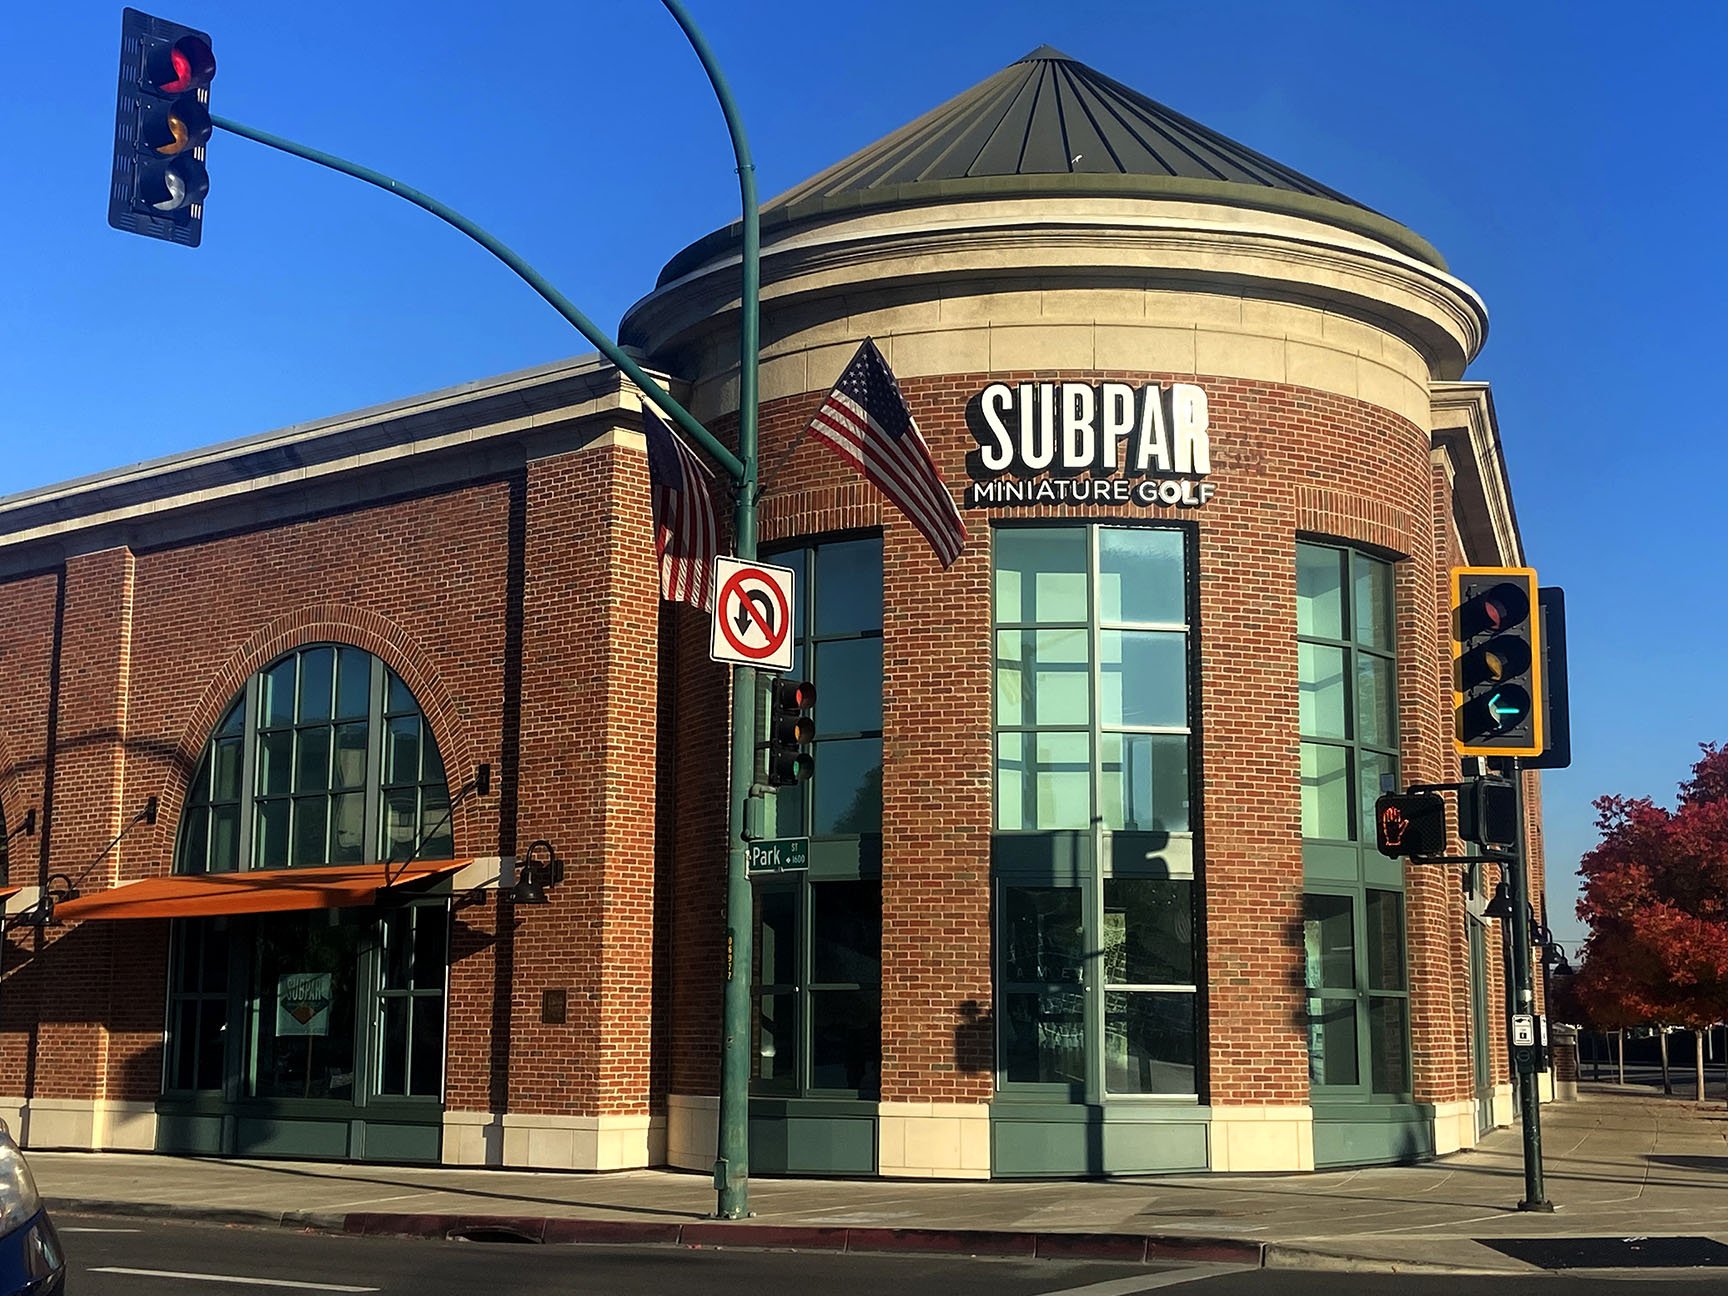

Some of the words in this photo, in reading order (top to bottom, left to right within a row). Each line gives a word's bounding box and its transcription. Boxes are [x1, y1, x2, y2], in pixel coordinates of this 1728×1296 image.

[980, 382, 1212, 475] SUBPAR
[973, 480, 1130, 503] MINIATURE
[1138, 479, 1218, 505] GOLF
[752, 845, 781, 866] Park
[791, 842, 799, 852] ST
